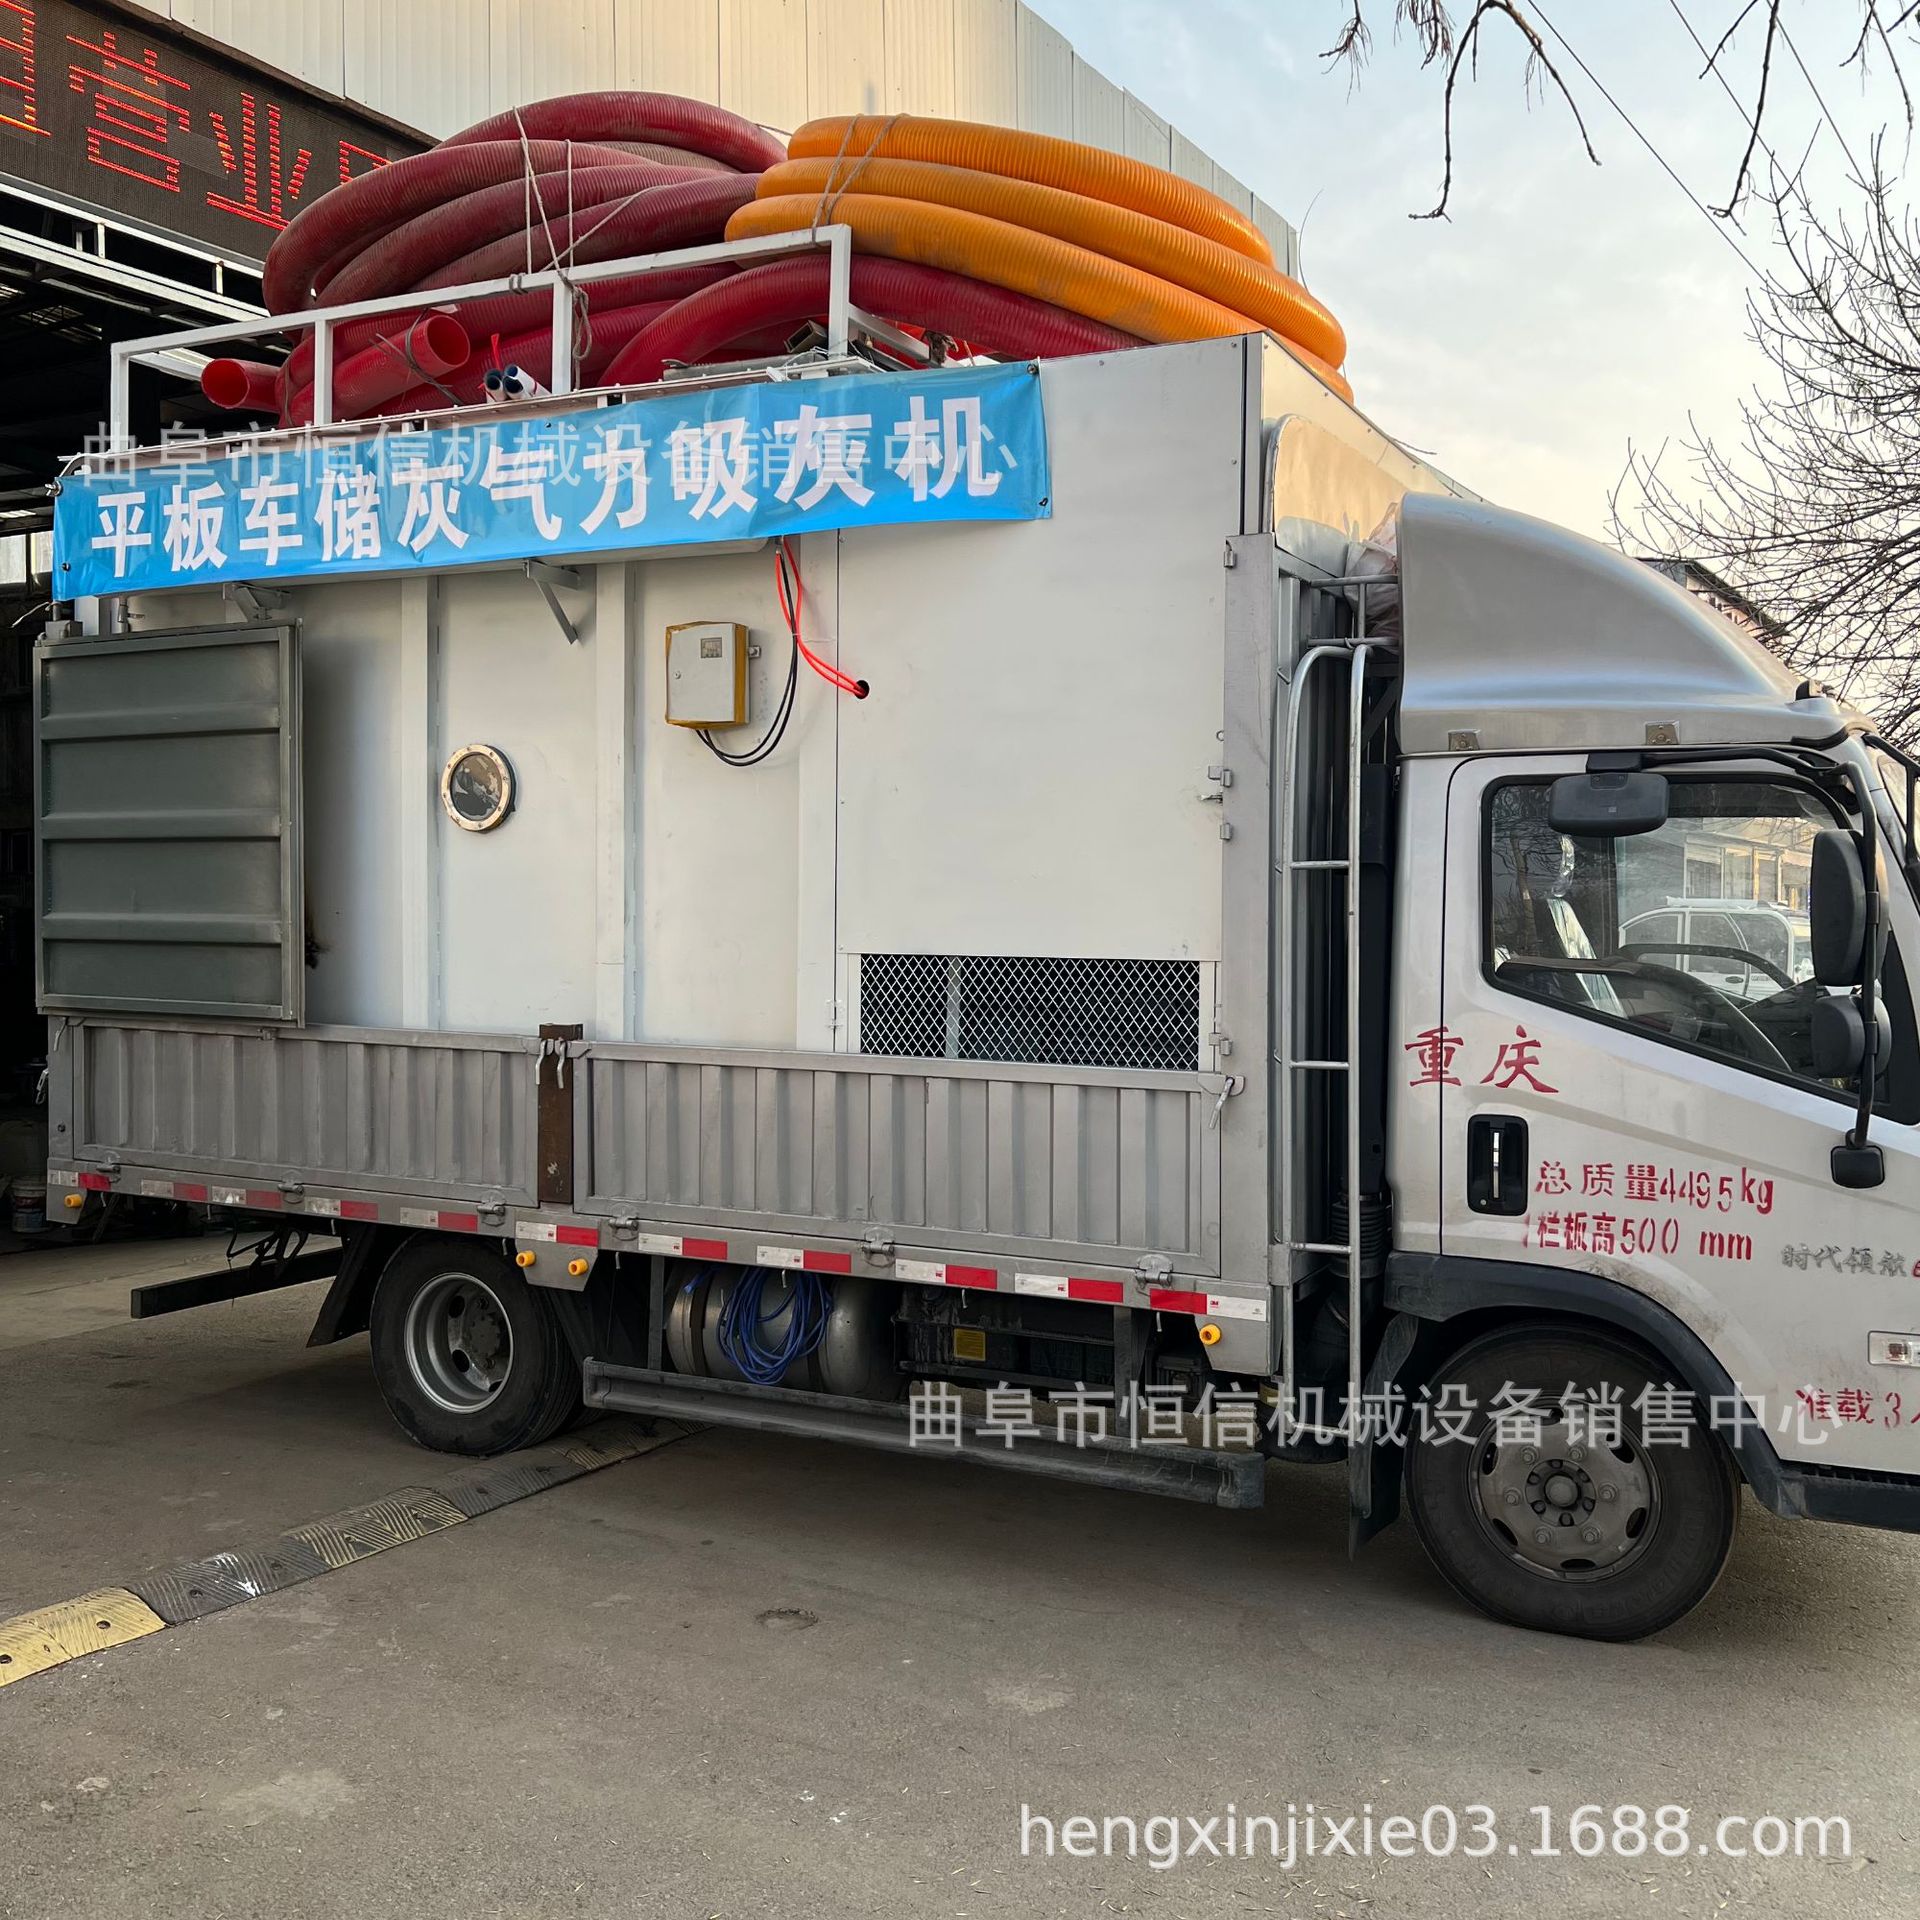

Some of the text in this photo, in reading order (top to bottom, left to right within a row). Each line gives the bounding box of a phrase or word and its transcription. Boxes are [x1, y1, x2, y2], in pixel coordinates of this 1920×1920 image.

[0, 0, 392, 231] 营业
[91, 395, 1003, 578] 平板车储灰气力吸灰机
[1404, 1024, 1559, 1094] 重庆
